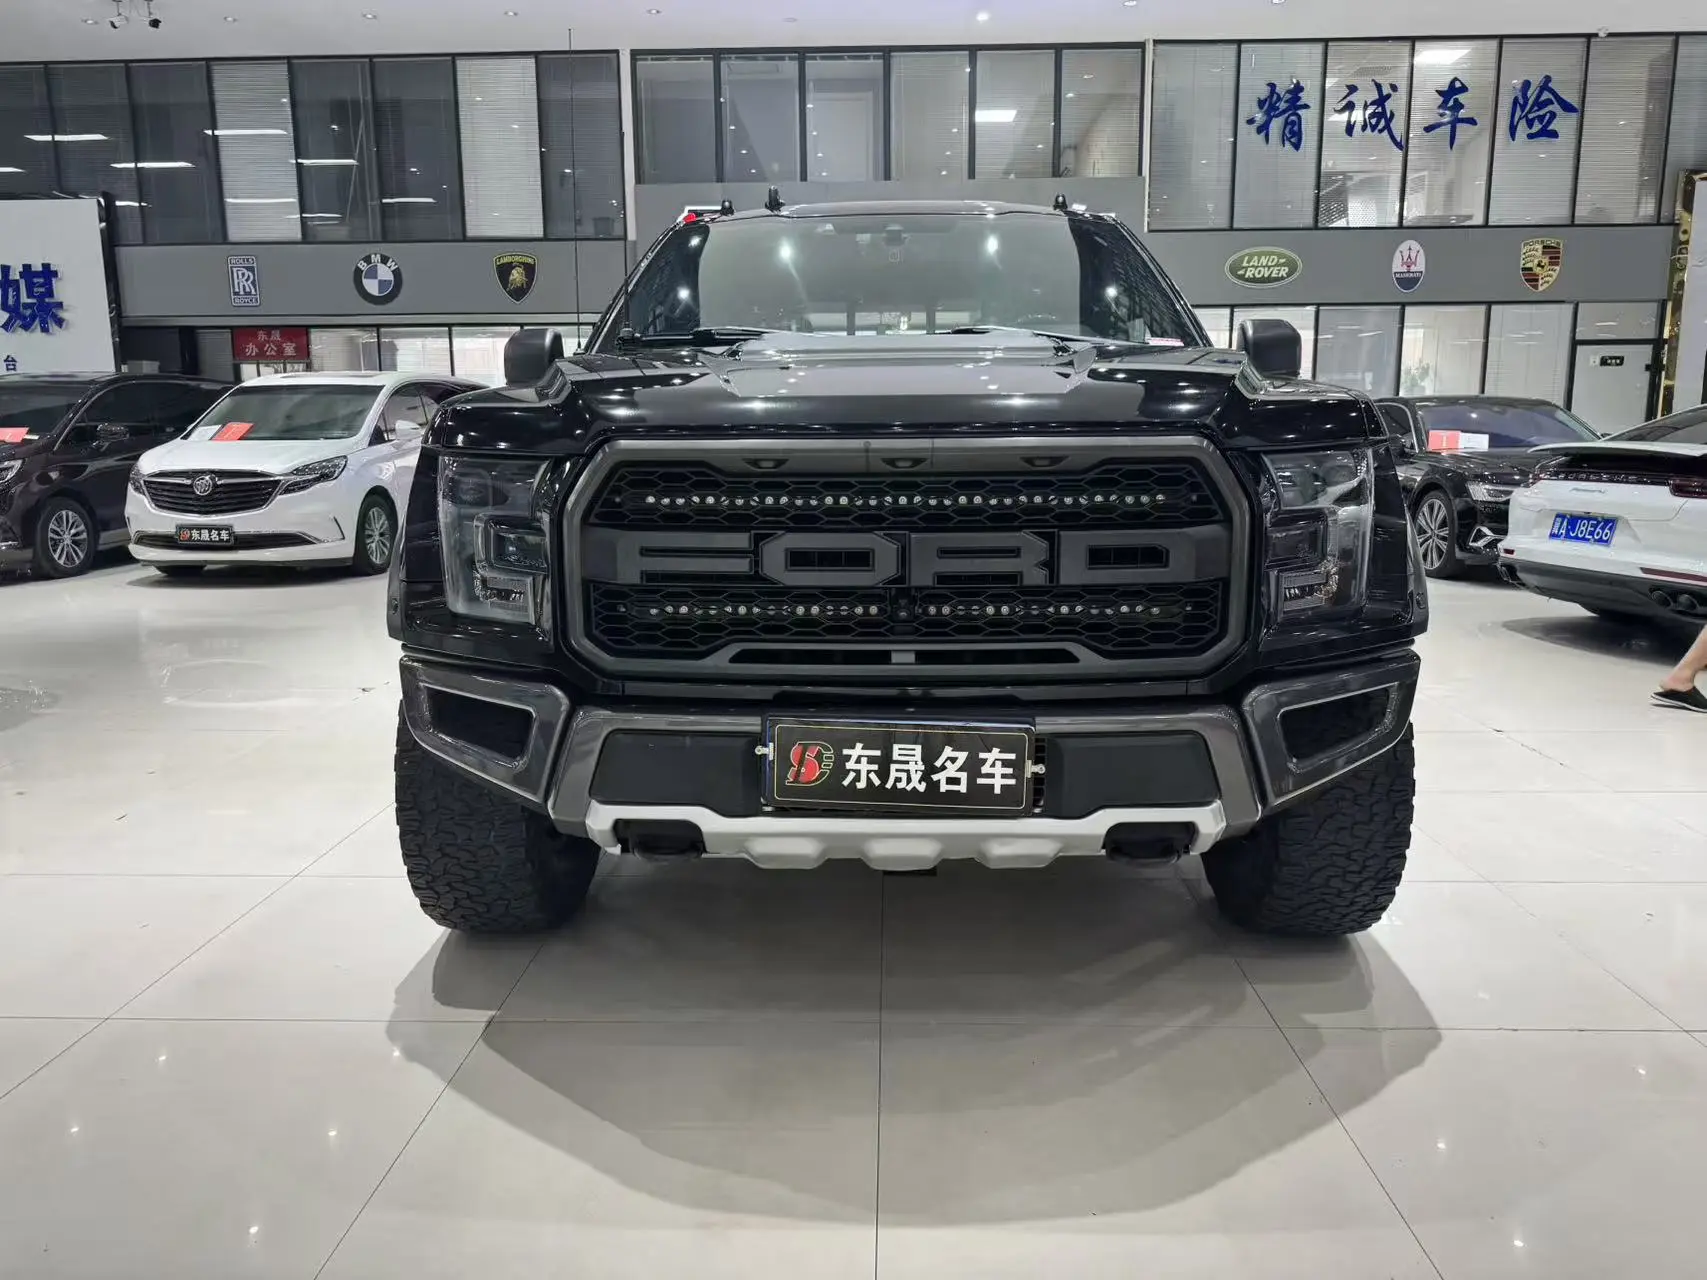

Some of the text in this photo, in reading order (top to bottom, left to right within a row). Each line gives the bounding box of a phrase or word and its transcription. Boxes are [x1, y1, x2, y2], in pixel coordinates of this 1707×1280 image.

[1246, 74, 1580, 152] 精诚车险
[357, 253, 399, 271] BMW
[1242, 255, 1278, 267] LAND
[1244, 266, 1289, 278] ROVER
[245, 342, 297, 357] 办公室
[191, 529, 230, 541] 东晟名车
[612, 530, 1190, 586] FORD
[842, 742, 1017, 795] 东晟名车
